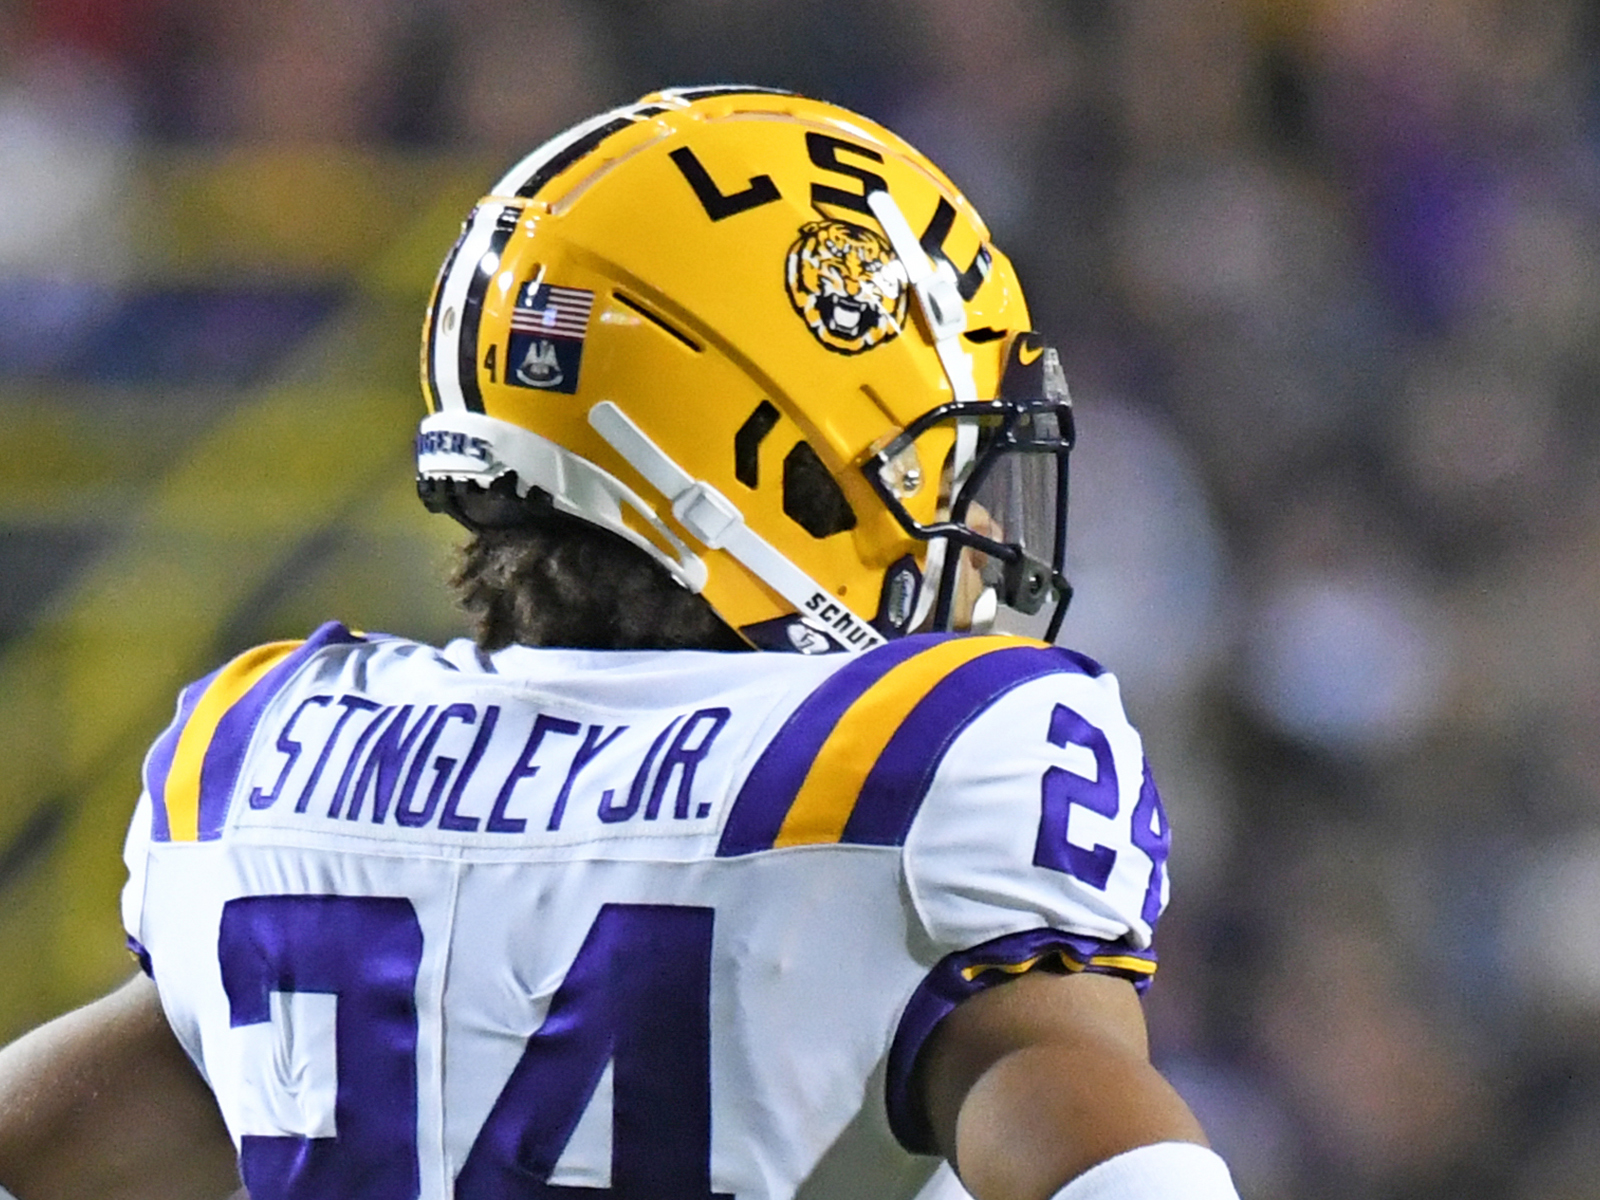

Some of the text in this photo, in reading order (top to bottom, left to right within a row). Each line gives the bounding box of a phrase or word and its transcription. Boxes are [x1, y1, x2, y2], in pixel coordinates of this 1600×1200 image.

[668, 131, 992, 303] LSU
[483, 344, 497, 383] 4
[249, 695, 731, 833] STINGLEY JR.
[1033, 702, 1172, 924] 24
